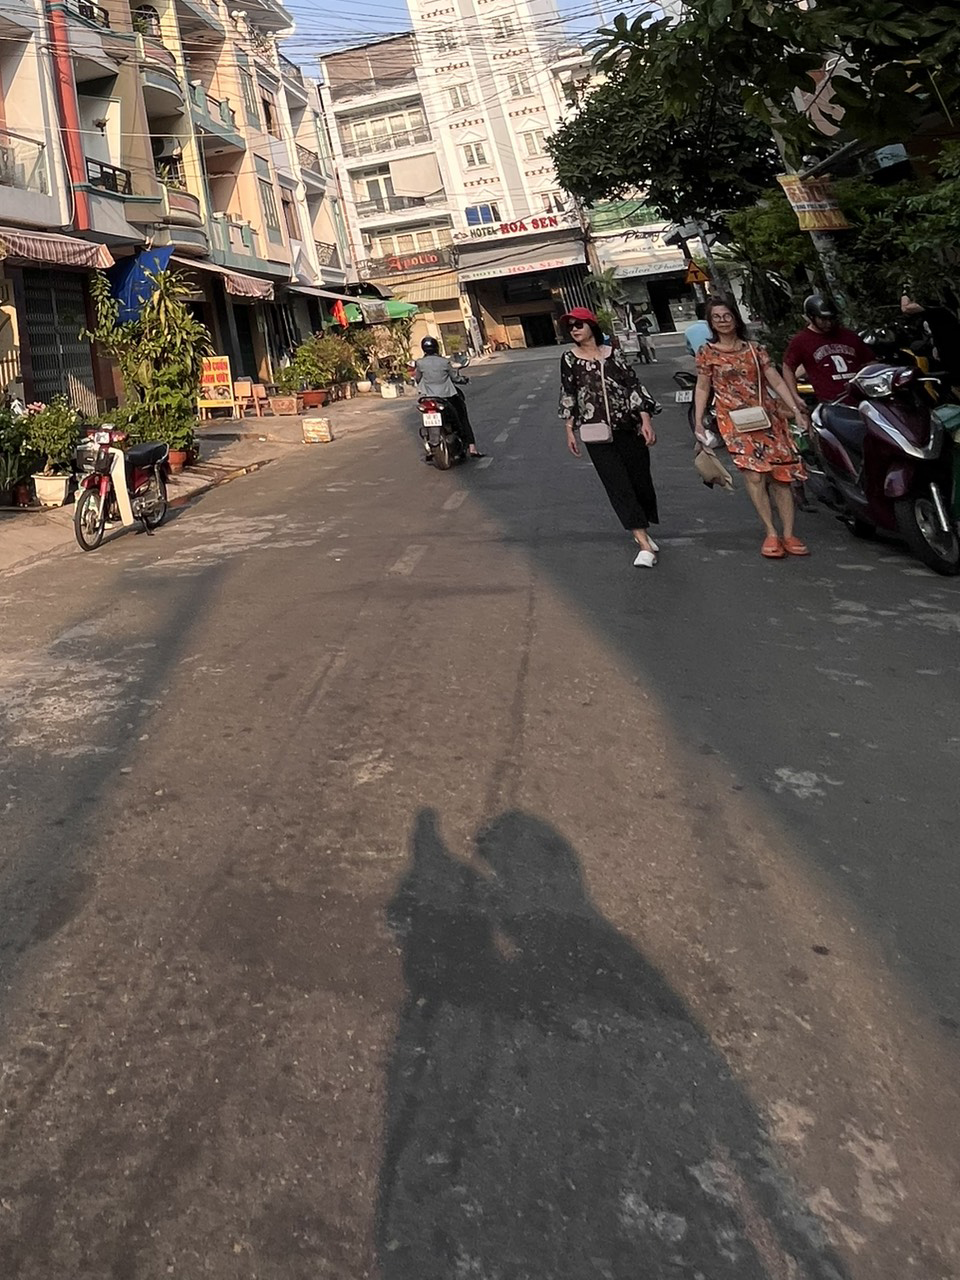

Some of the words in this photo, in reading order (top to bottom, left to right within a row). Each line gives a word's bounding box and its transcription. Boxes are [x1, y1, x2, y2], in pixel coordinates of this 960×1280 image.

[470, 226, 497, 238] HOTEL
[499, 219, 528, 235] HOA
[531, 215, 558, 229] SEN
[384, 253, 438, 271] Apollo
[508, 264, 535, 274] HOA
[539, 259, 565, 269] SEN
